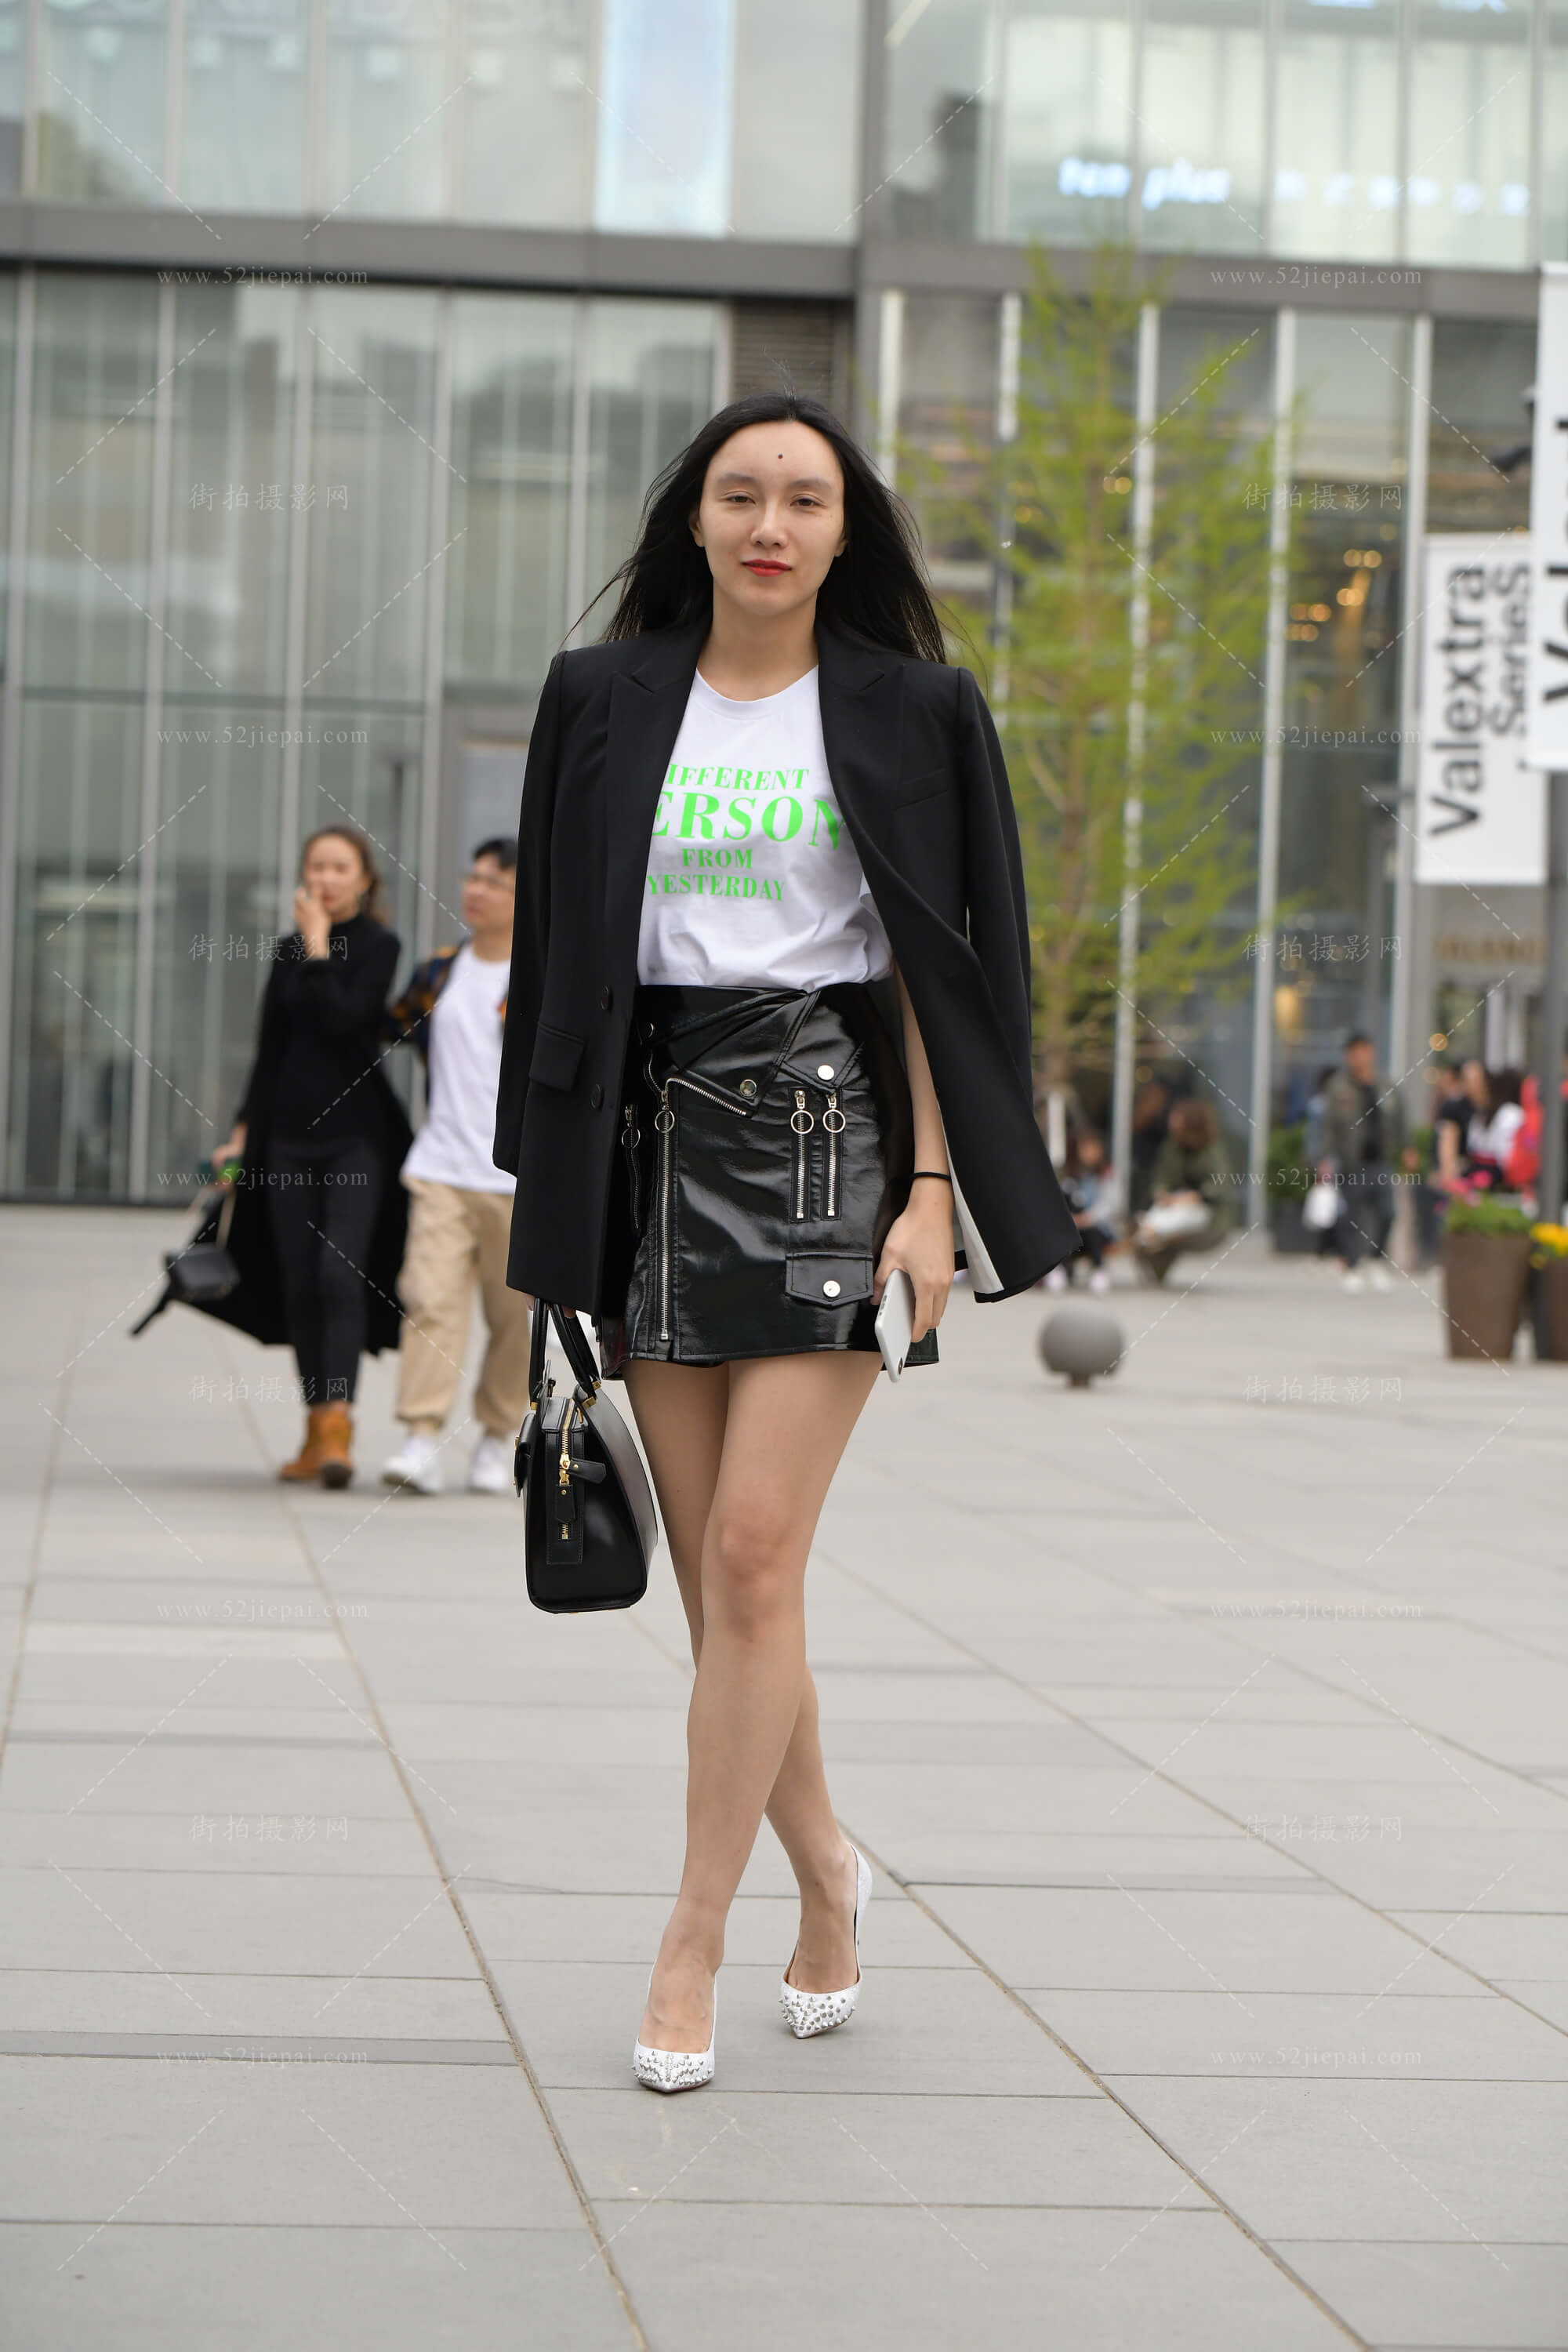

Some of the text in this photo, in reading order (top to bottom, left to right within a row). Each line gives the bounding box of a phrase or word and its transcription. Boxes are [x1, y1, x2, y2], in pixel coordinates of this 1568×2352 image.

[1430, 564, 1484, 837] Valextra
[665, 764, 810, 791] IFFERENT
[652, 790, 844, 851] ERSON
[681, 848, 753, 869] FROM
[646, 874, 785, 902] YESTERDAY
